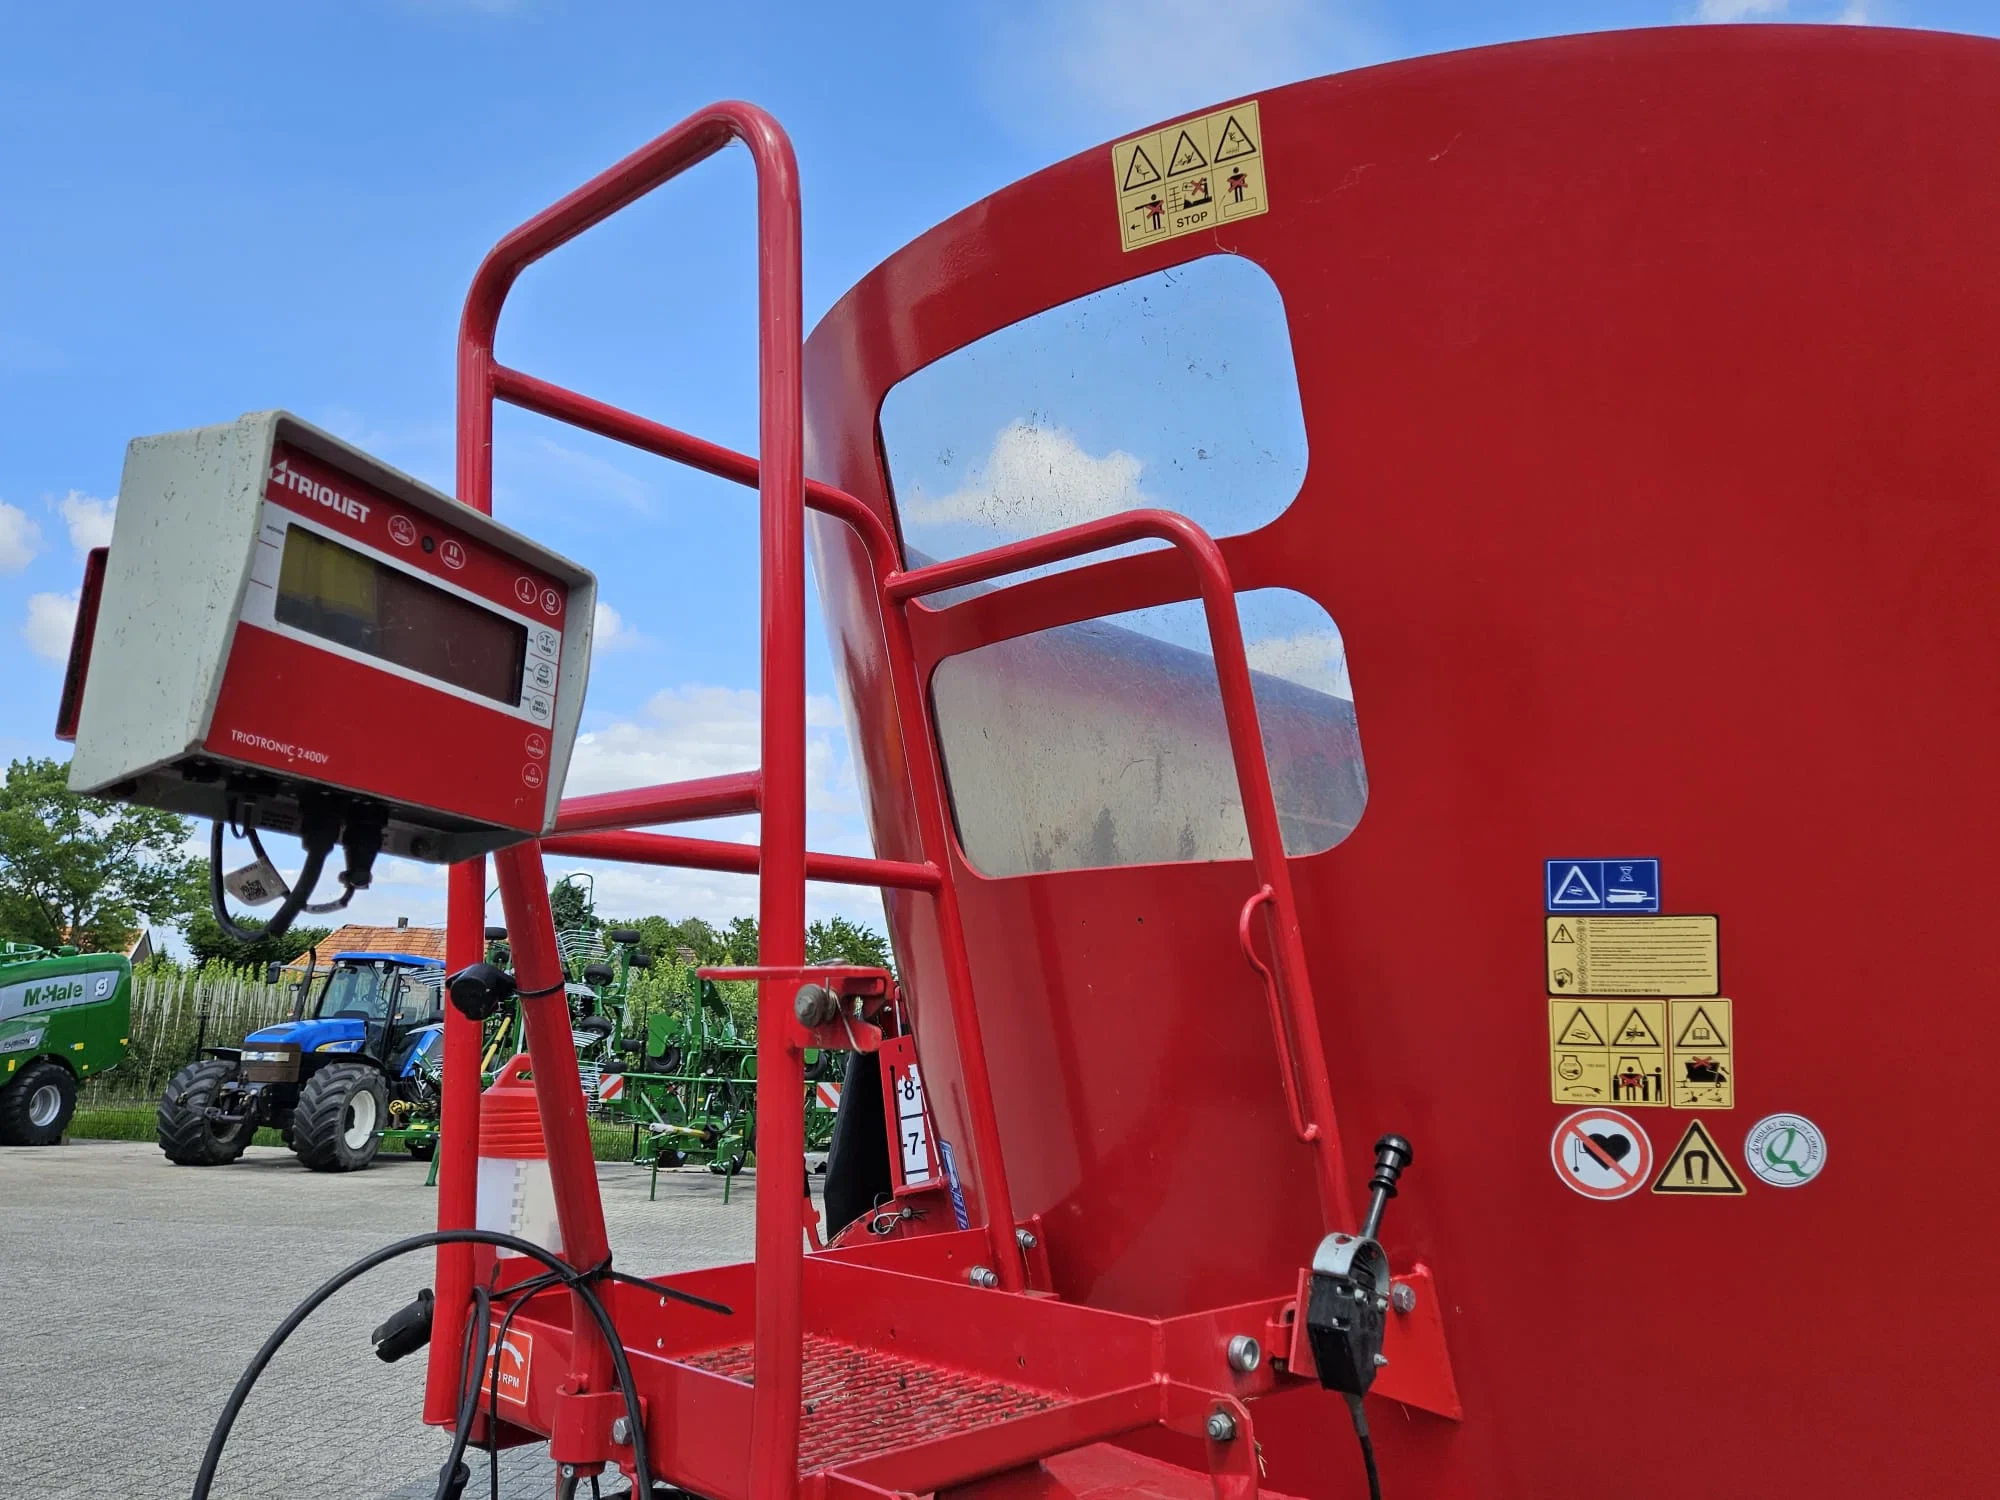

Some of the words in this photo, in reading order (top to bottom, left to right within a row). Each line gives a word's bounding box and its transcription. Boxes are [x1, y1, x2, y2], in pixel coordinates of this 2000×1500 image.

[1176, 211, 1208, 228] STOP
[286, 469, 371, 524] TRIOLIET
[231, 729, 295, 756] TRIOTRONIC
[297, 747, 329, 765] 2400V
[904, 1079, 915, 1100] 8
[908, 1132, 919, 1155] 7
[502, 1372, 520, 1389] RPM
